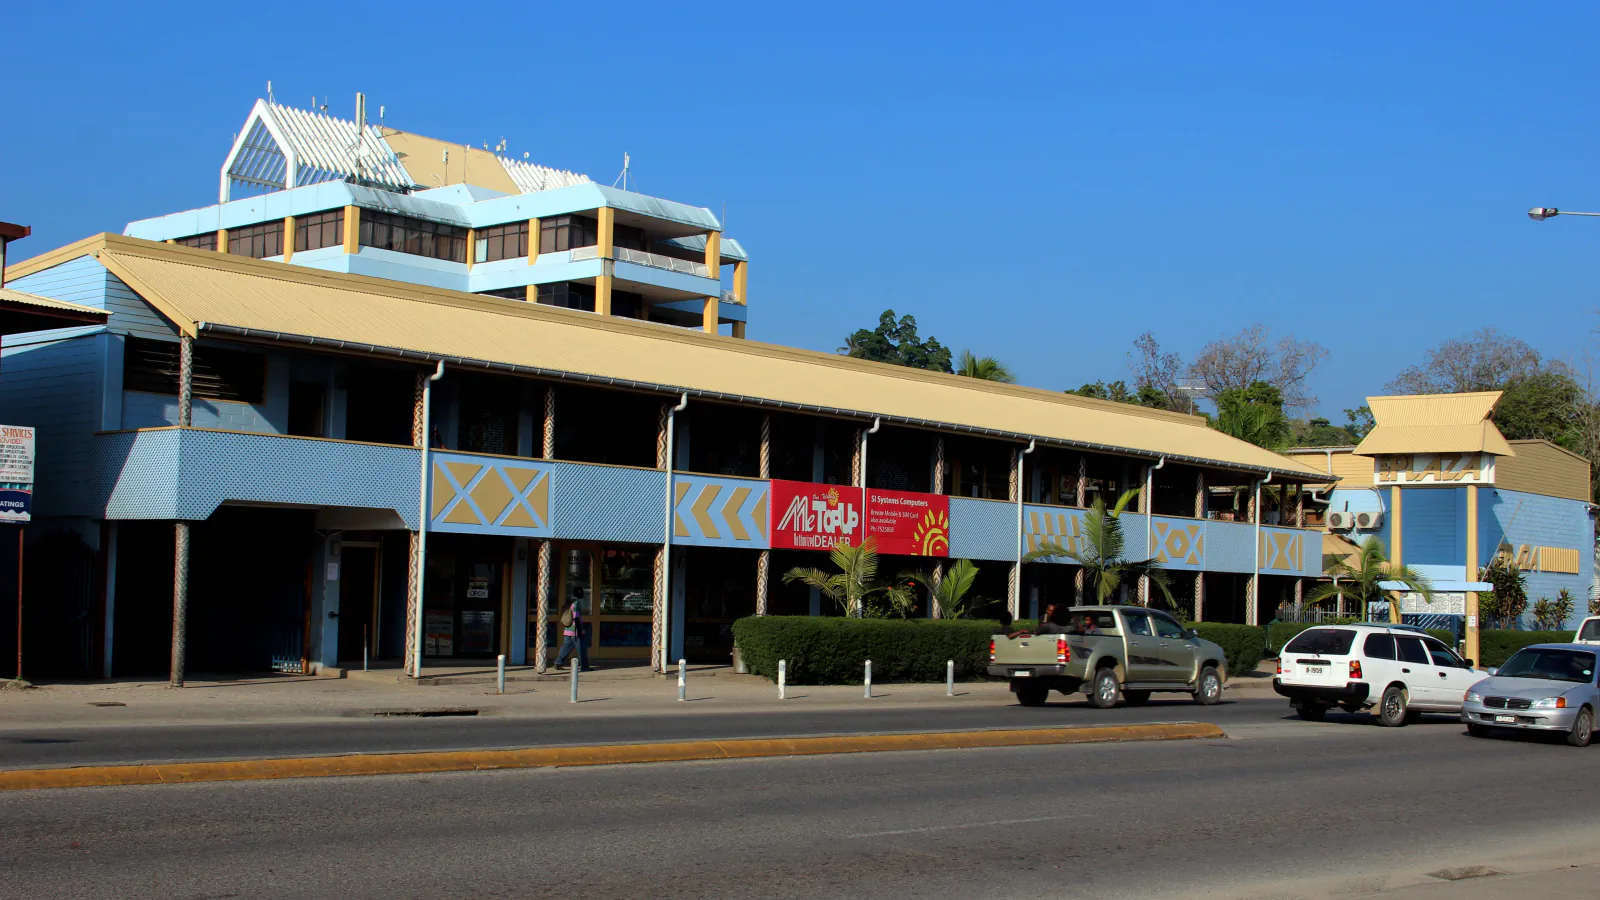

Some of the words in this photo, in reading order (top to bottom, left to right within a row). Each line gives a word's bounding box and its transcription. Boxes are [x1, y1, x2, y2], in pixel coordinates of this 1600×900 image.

[1390, 454, 1480, 482] PLAZA
[871, 495, 876, 503] SI
[877, 495, 899, 505] Systems
[900, 498, 928, 507] Computers
[910, 511, 919, 519] Card
